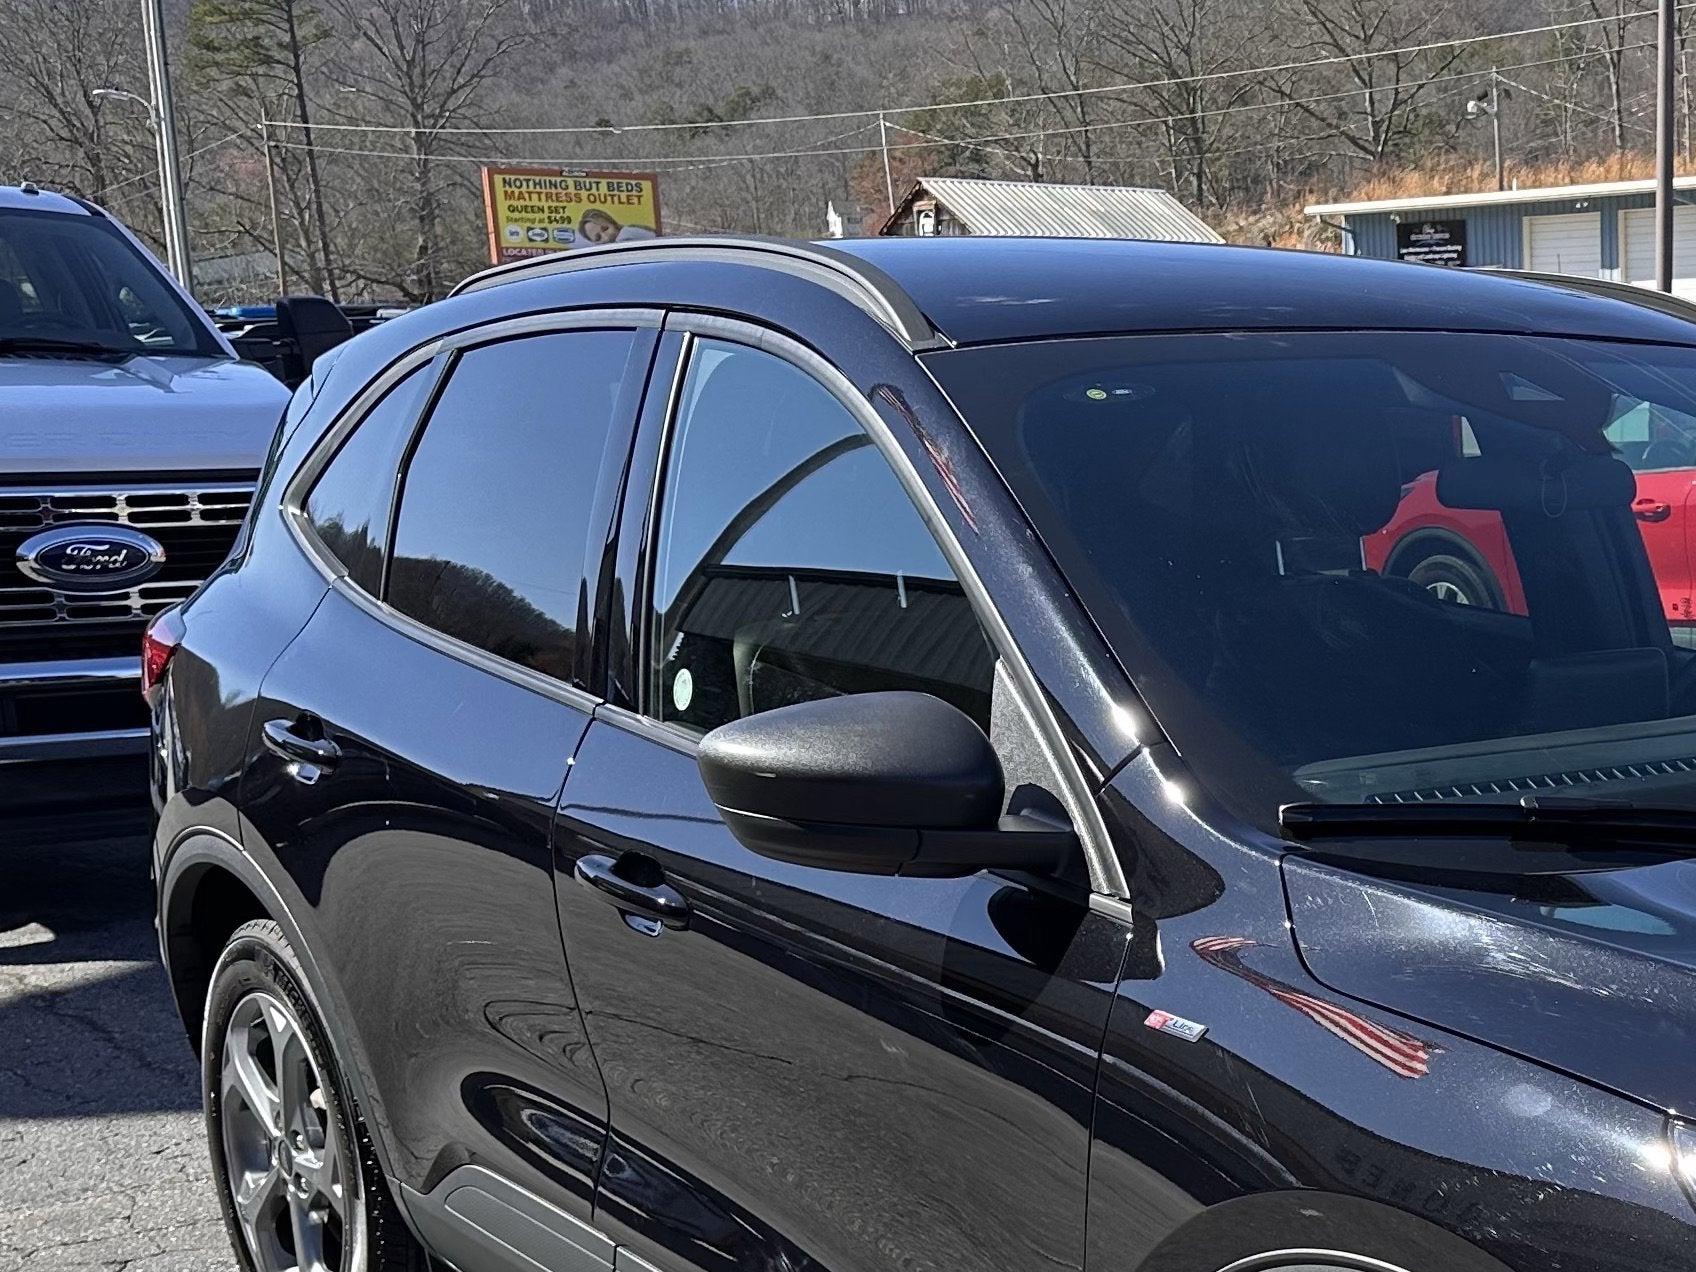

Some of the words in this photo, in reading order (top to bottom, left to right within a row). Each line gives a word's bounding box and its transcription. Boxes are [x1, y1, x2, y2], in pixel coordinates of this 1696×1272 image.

[503, 177, 570, 191] NOTHING
[573, 180, 602, 192] BUT
[606, 181, 644, 194] BEDS
[503, 190, 583, 204] MATTRESS
[587, 193, 644, 206] OUTLET
[507, 204, 545, 215] QUEEN
[547, 206, 567, 215] SET
[547, 215, 572, 225] $499
[61, 543, 129, 570] Ford
